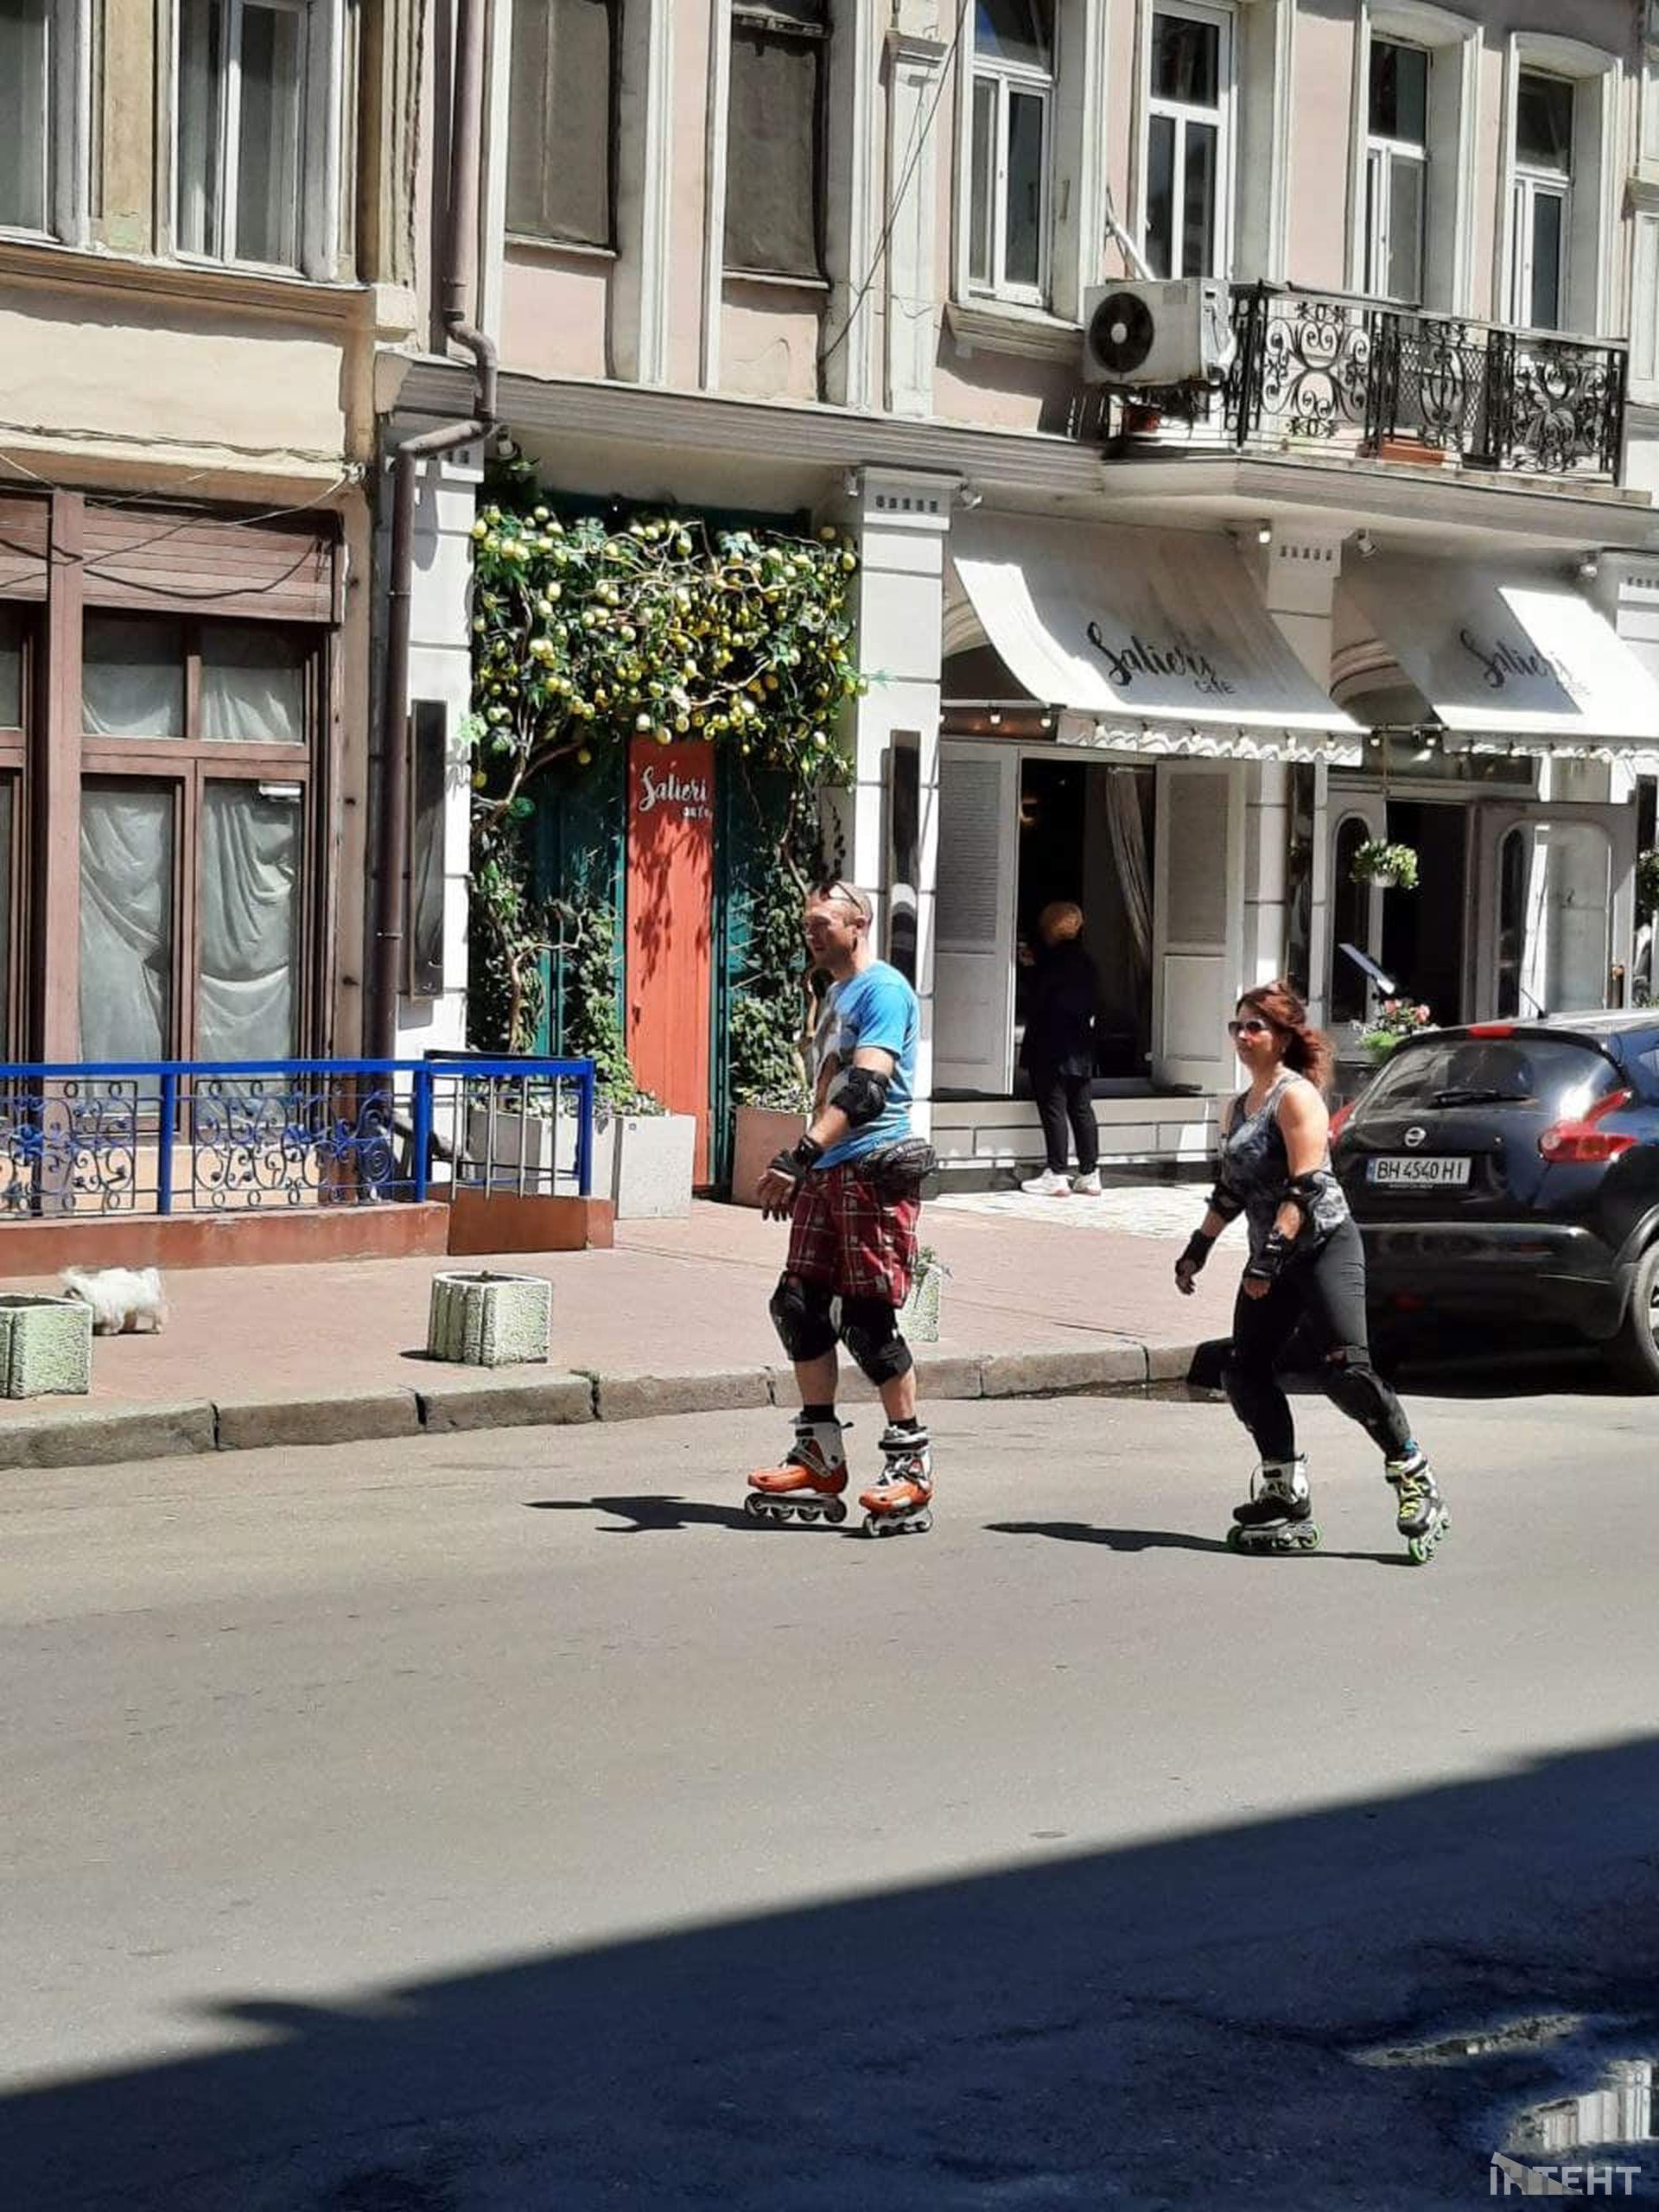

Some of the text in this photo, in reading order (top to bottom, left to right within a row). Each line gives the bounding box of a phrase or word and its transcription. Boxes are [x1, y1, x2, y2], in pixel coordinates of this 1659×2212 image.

[639, 766, 707, 811] Salieri
[1377, 1160, 1462, 1180] BH 4540 HI
